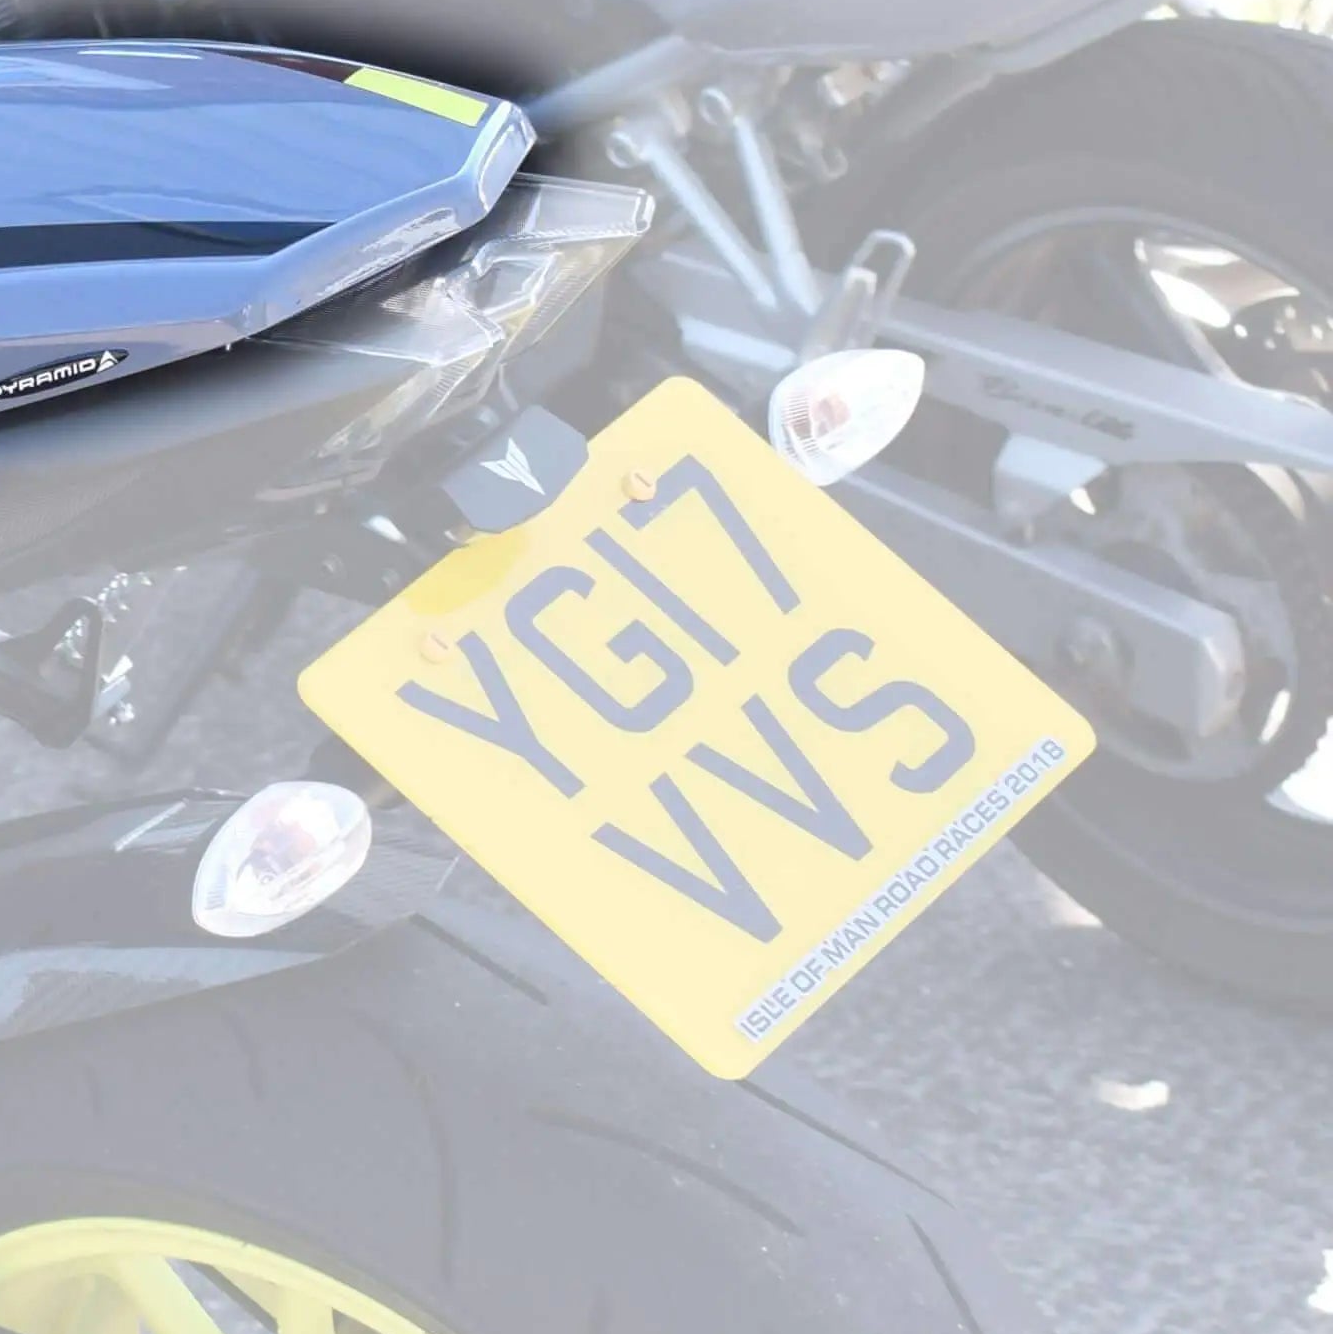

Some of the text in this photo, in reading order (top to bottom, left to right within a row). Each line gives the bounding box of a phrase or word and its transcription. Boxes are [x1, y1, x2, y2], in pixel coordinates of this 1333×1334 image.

[395, 454, 801, 800] YG17
[591, 628, 976, 944] VVS
[739, 740, 1066, 1040] ISLE OF MAN ROAD RACES 2018
